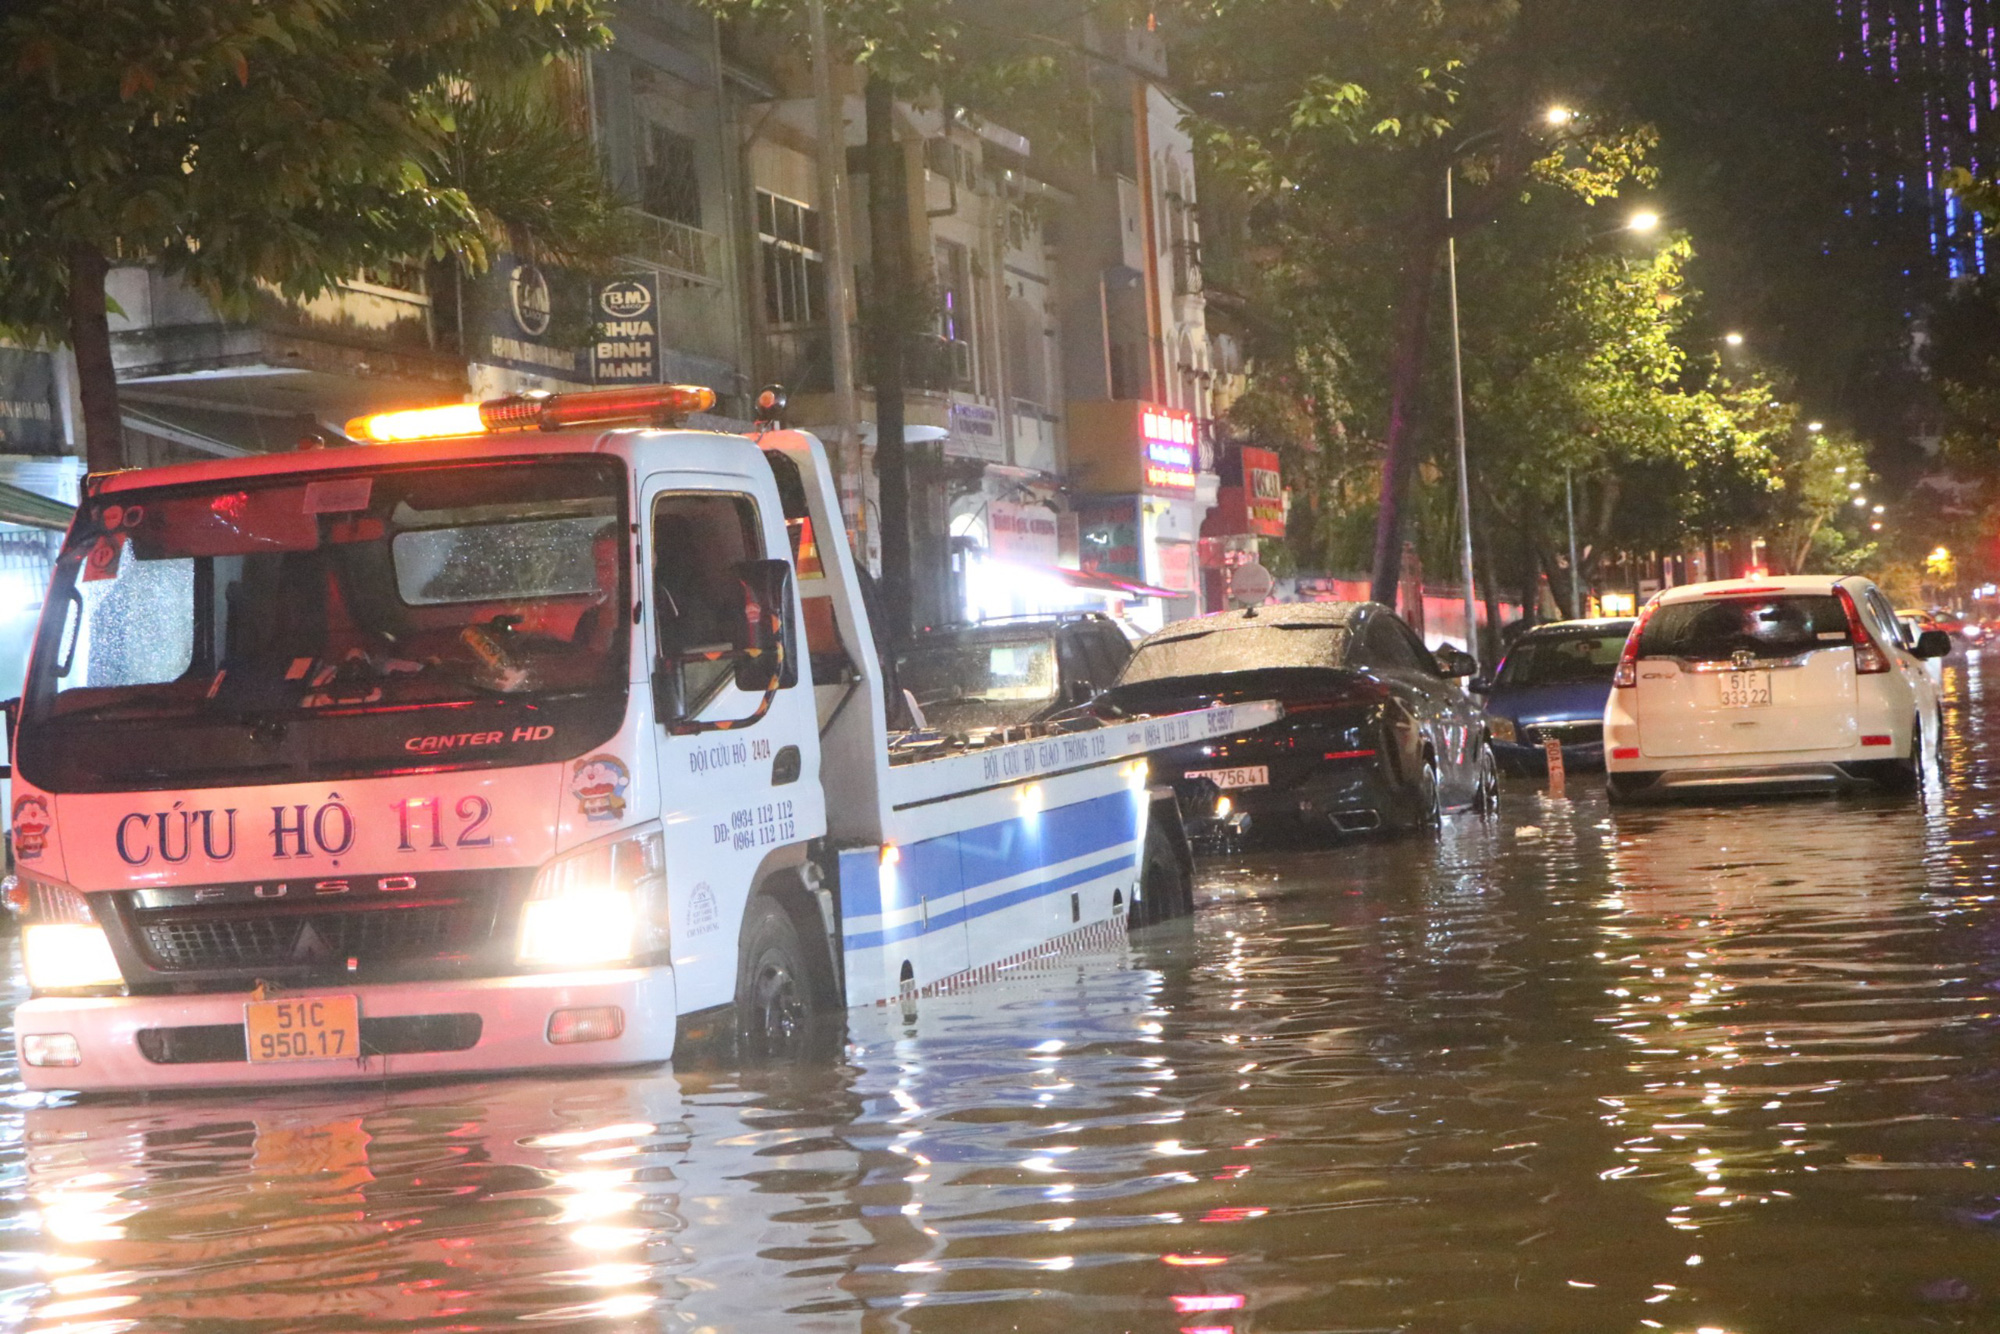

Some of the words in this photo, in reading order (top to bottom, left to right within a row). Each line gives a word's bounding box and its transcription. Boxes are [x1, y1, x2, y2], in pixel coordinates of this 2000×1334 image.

[610, 291, 641, 305] BM
[1731, 673, 1756, 690] 51F
[405, 731, 503, 752] CANTER
[512, 725, 555, 743] HD
[1040, 742, 1060, 768] GIAO
[1063, 736, 1088, 762] THÔNG
[1091, 735, 1106, 756] 112
[689, 745, 708, 776] ĐỘI
[710, 742, 731, 769] CỨU
[732, 737, 747, 768] HỘ
[752, 739, 771, 760] 24/24
[731, 808, 754, 830] 0934
[758, 804, 774, 824] 112
[777, 800, 793, 819] 112
[115, 801, 237, 867] CỨU
[270, 793, 356, 866] HỘ
[389, 795, 495, 852] 112
[733, 829, 755, 851] 0964
[759, 824, 776, 845] 112
[779, 820, 795, 840] 112
[195, 876, 416, 901] FUSO
[277, 1002, 325, 1029] 51C
[260, 1029, 345, 1058] 950.17
